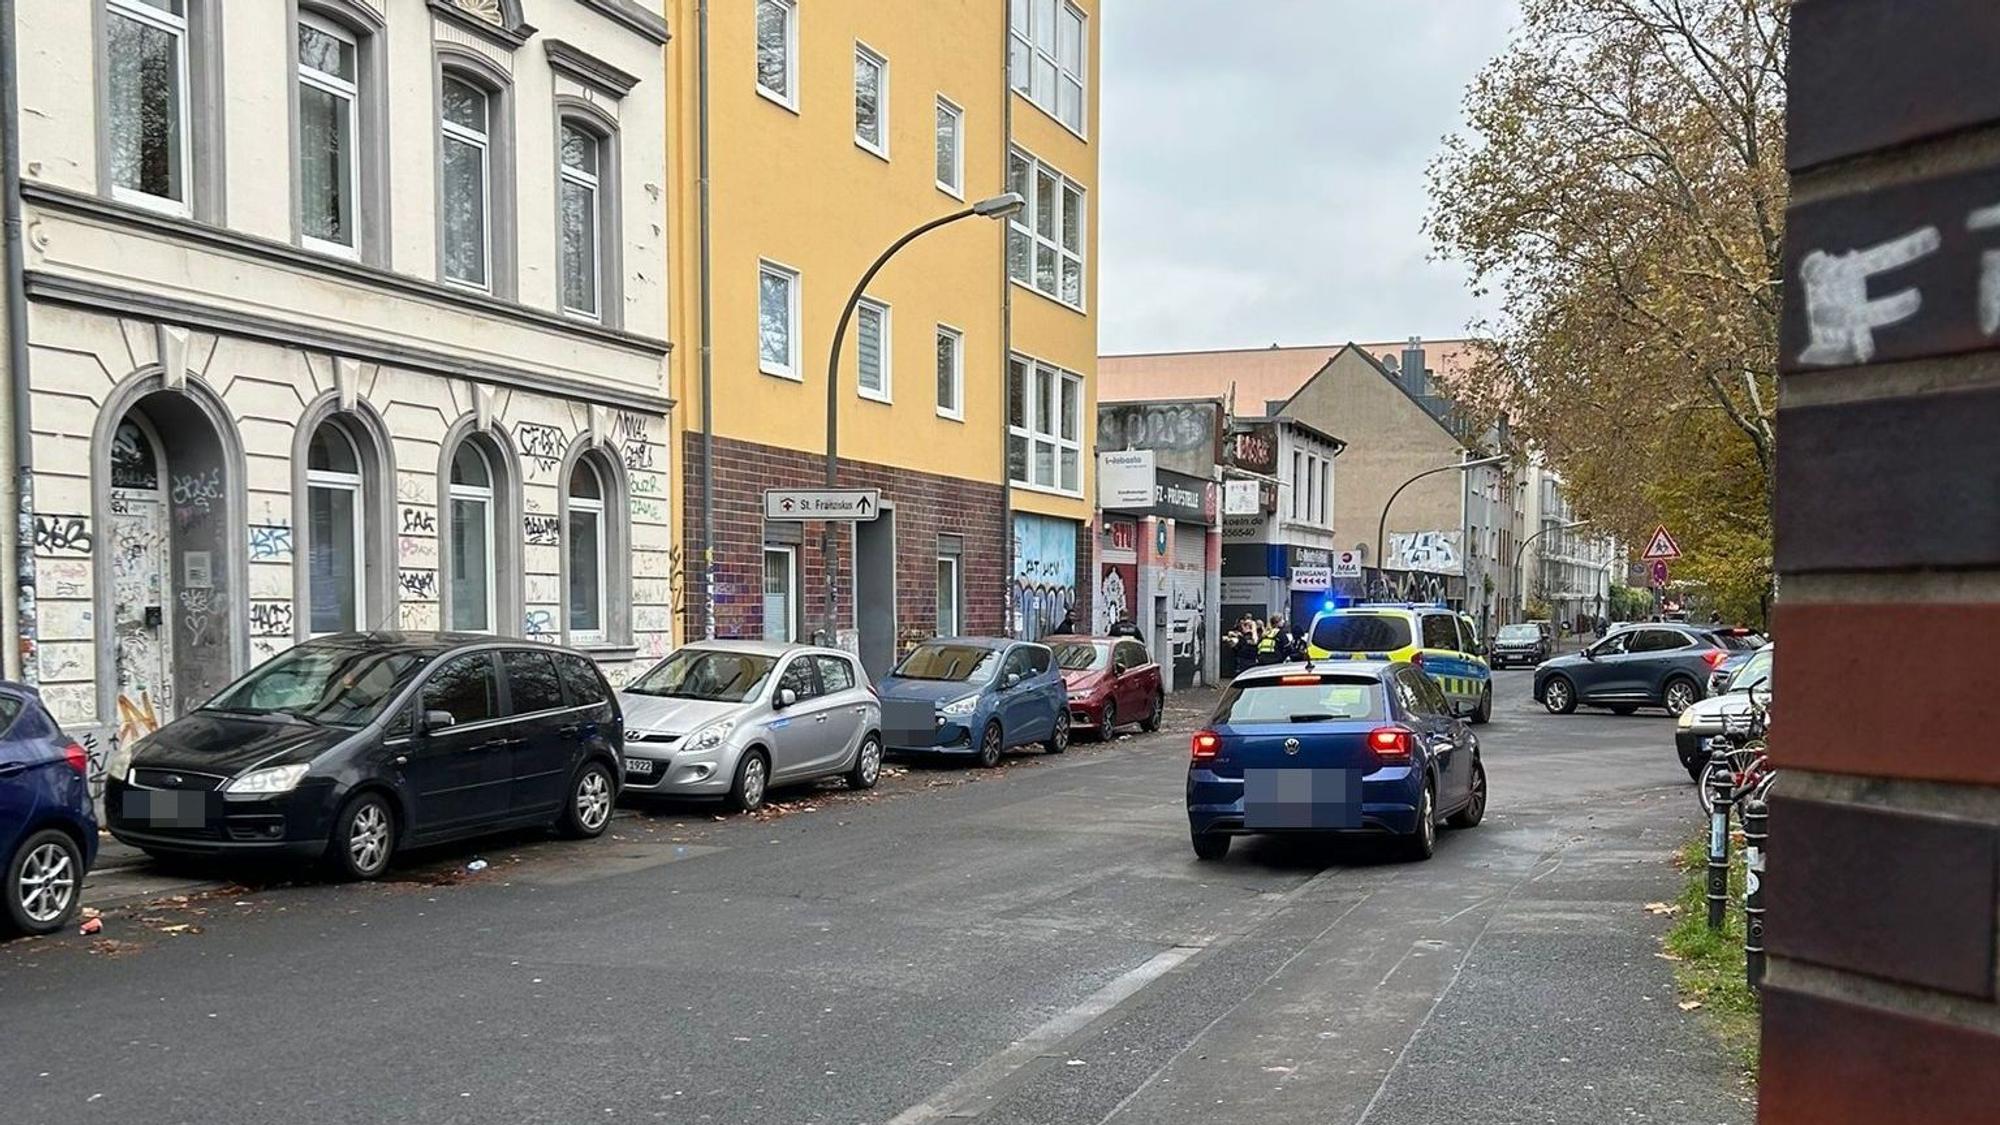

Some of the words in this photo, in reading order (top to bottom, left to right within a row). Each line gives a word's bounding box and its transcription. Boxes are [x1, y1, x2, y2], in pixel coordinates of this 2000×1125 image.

[800, 499, 812, 510] St.
[815, 499, 853, 510] Franziskus
[628, 760, 651, 770] 1922
